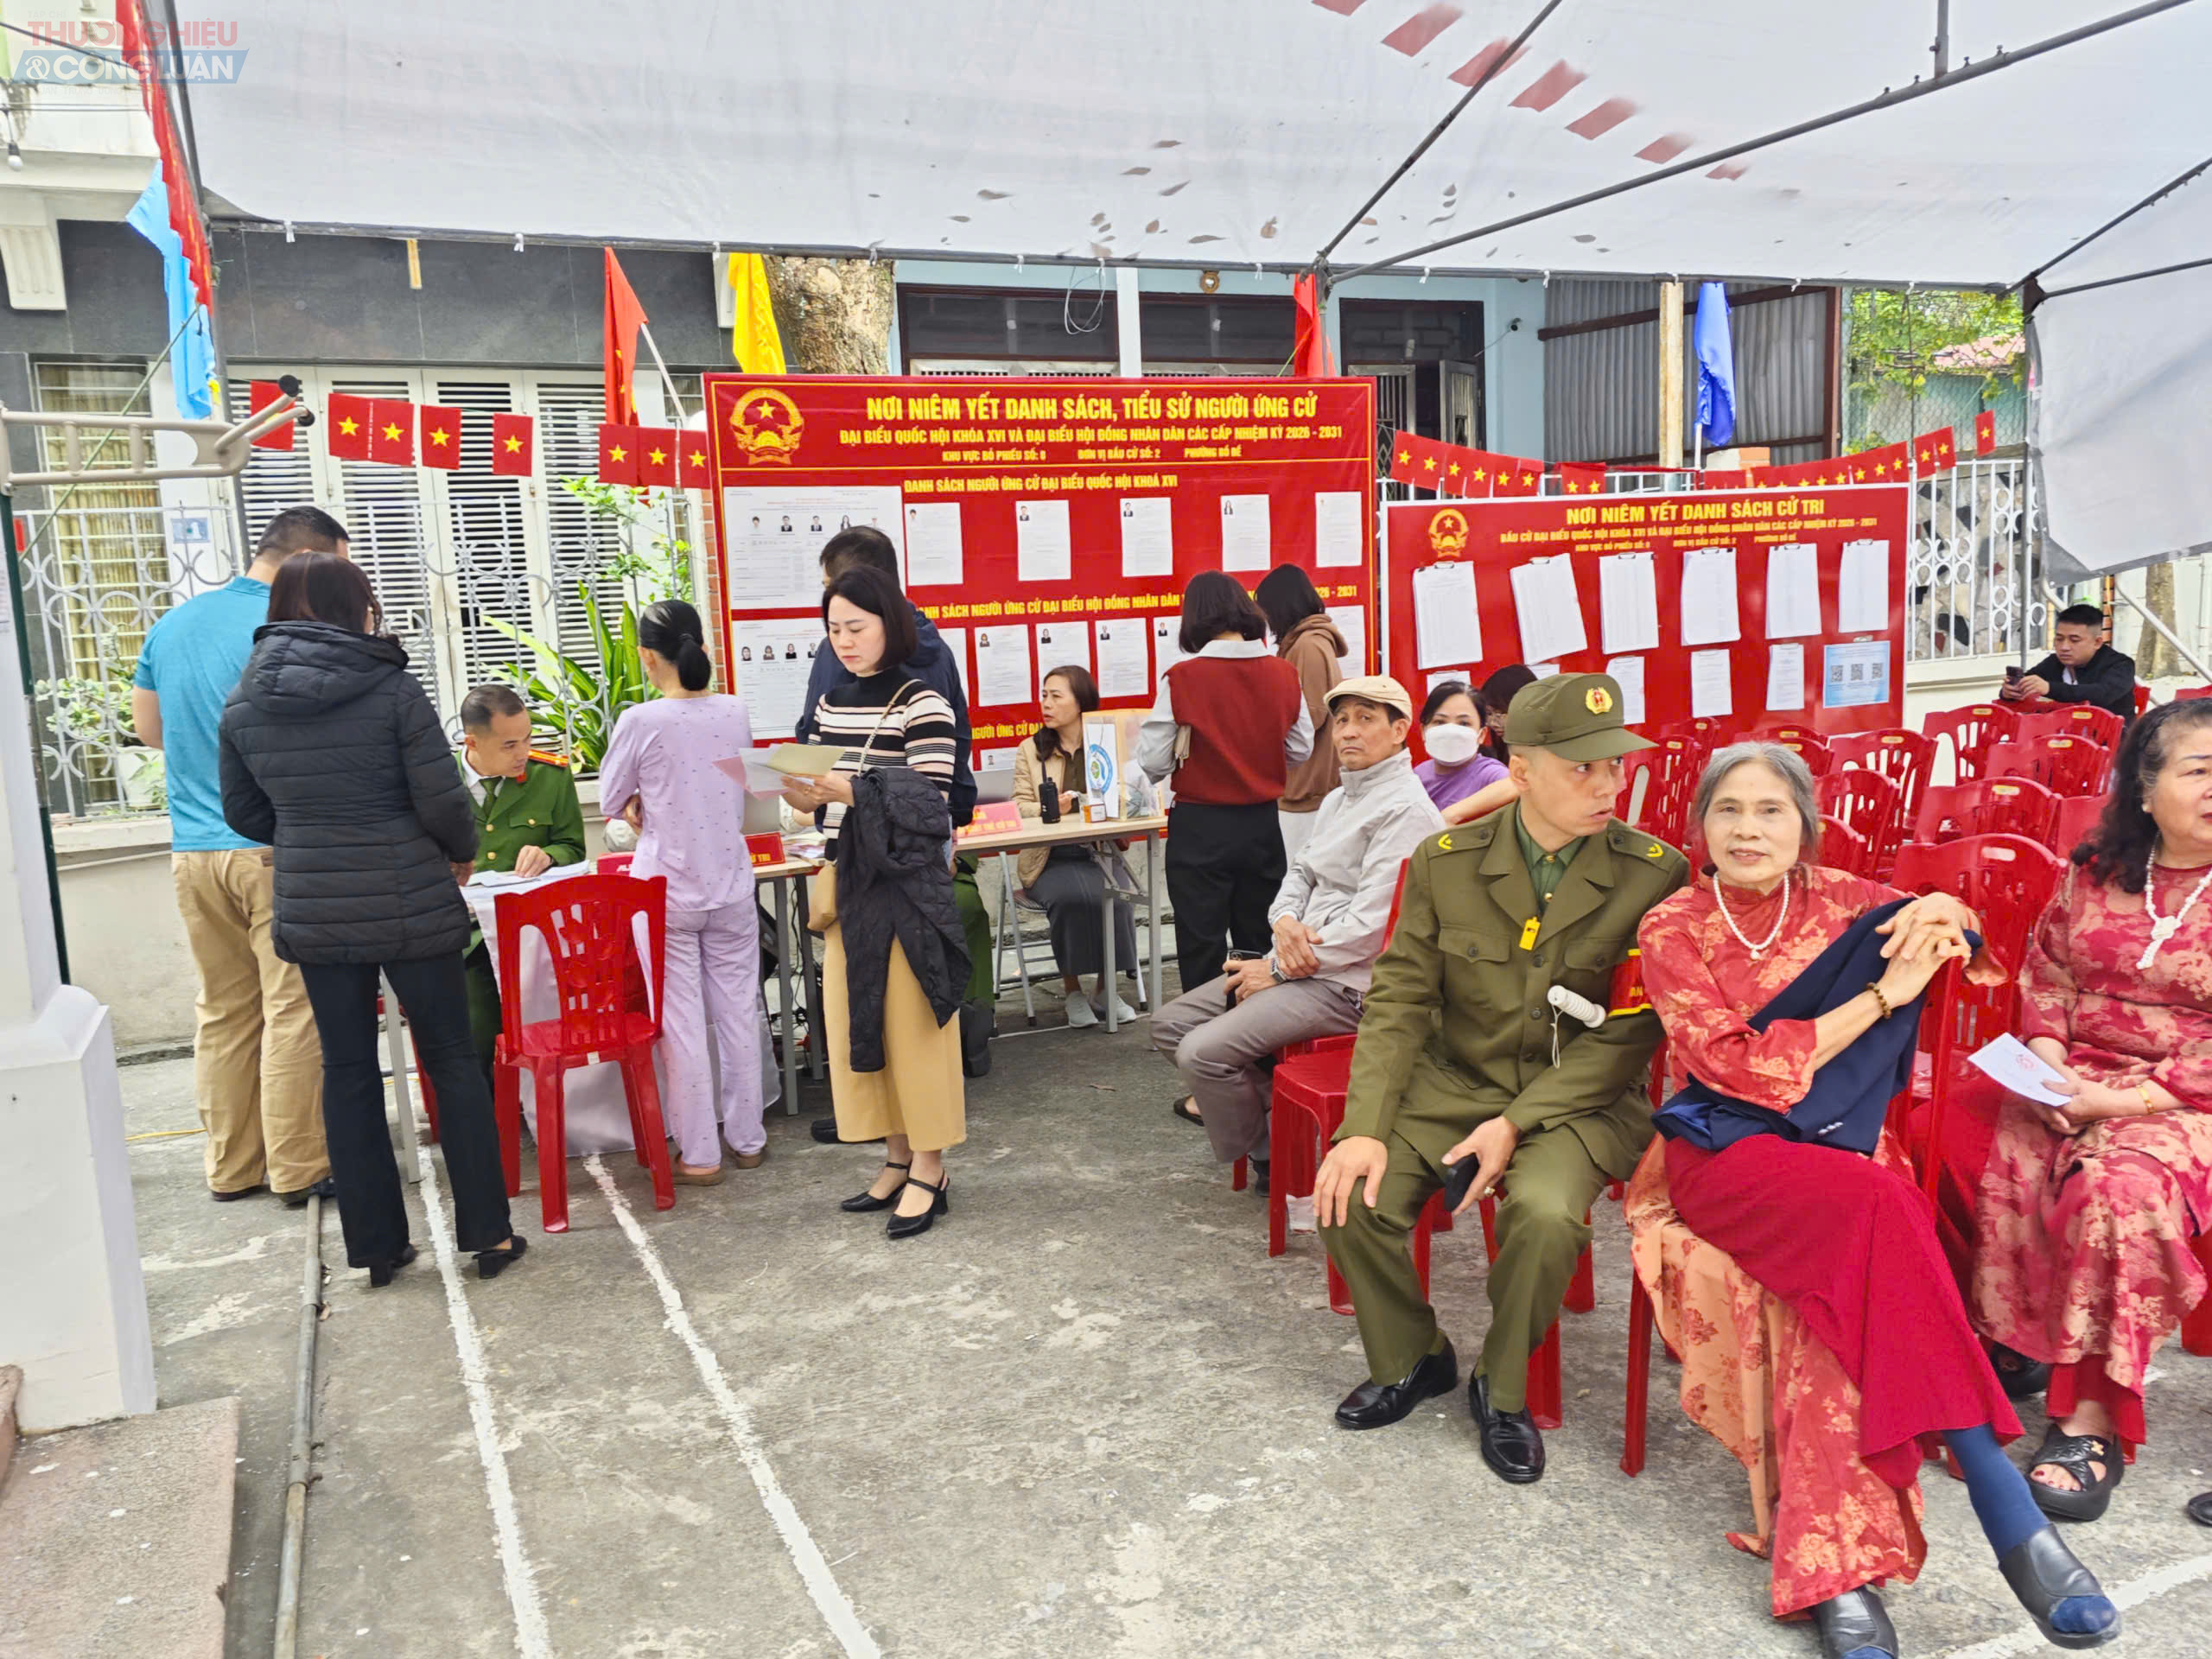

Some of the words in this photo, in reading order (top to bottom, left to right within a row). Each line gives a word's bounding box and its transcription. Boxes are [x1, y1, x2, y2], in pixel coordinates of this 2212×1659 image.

[868, 396, 902, 420] NƠI
[908, 394, 961, 420] NIÊM
[966, 391, 1000, 420] YẾT
[1006, 397, 1057, 420] DANH
[1062, 394, 1117, 421] SÁCH,
[1122, 389, 1161, 418] TIỂU
[1166, 391, 1192, 418] SỬ
[1195, 393, 1248, 418] NGƯỜI
[1254, 394, 1288, 417] ỨNG
[1293, 390, 1318, 417] CỬ
[840, 430, 861, 446] ĐẠI
[895, 425, 926, 444] QUỐC
[930, 427, 950, 446] HỘI
[952, 428, 983, 442] KHÓA
[987, 429, 1006, 442] XVI
[1009, 427, 1023, 442] VÀ
[1027, 429, 1046, 445] ĐẠI
[1077, 427, 1095, 444] HỘI
[1097, 425, 1127, 441] ĐỒNG
[1130, 425, 1160, 441] NHÂN
[1163, 425, 1185, 441] DÂN
[1187, 424, 1208, 441] CÁC
[1211, 423, 1232, 441] CẤP
[1235, 426, 1268, 442] NHIỆM
[1286, 427, 1310, 439] 2026
[1319, 426, 1341, 439] 2031
[943, 451, 961, 461] KHU
[1024, 448, 1039, 460] SỐ:
[1140, 445, 1154, 458] SỐ:
[1154, 449, 1160, 458] 2
[904, 480, 933, 493] DANH
[937, 477, 964, 492] SÁCH
[967, 476, 1001, 491] NGƯỜI
[1002, 476, 1023, 491] ỨNG
[1025, 474, 1040, 490] CỬ
[1042, 477, 1058, 492] ĐẠI
[1086, 473, 1113, 489] QUỐC
[1115, 474, 1132, 490] HỘI
[1134, 474, 1160, 487] KHOÁ
[1161, 475, 1178, 487] XVI
[1567, 506, 1597, 524] NƠI
[1601, 504, 1644, 523] NIÊM
[1649, 499, 1679, 521] YẾT
[1683, 503, 1726, 519] DANH
[1732, 499, 1773, 518] SÁCH
[1777, 495, 1799, 516] CỬ
[1802, 499, 1825, 514] TRI
[942, 603, 969, 618] SÁCH
[971, 601, 1001, 617] NGƯỜI
[1004, 601, 1025, 615] ỨNG
[1027, 599, 1041, 613] CỬ
[1043, 601, 1060, 615] ĐẠI
[1086, 597, 1103, 613] HỘI
[1104, 594, 1130, 609] ĐỒNG
[1132, 594, 1159, 608] NHÂN
[1161, 593, 1179, 607] DÂN
[1338, 586, 1357, 597] 2031
[972, 723, 995, 739] GƯỜI
[996, 723, 1014, 737] ỨNG
[1016, 720, 1027, 735] CỬ
